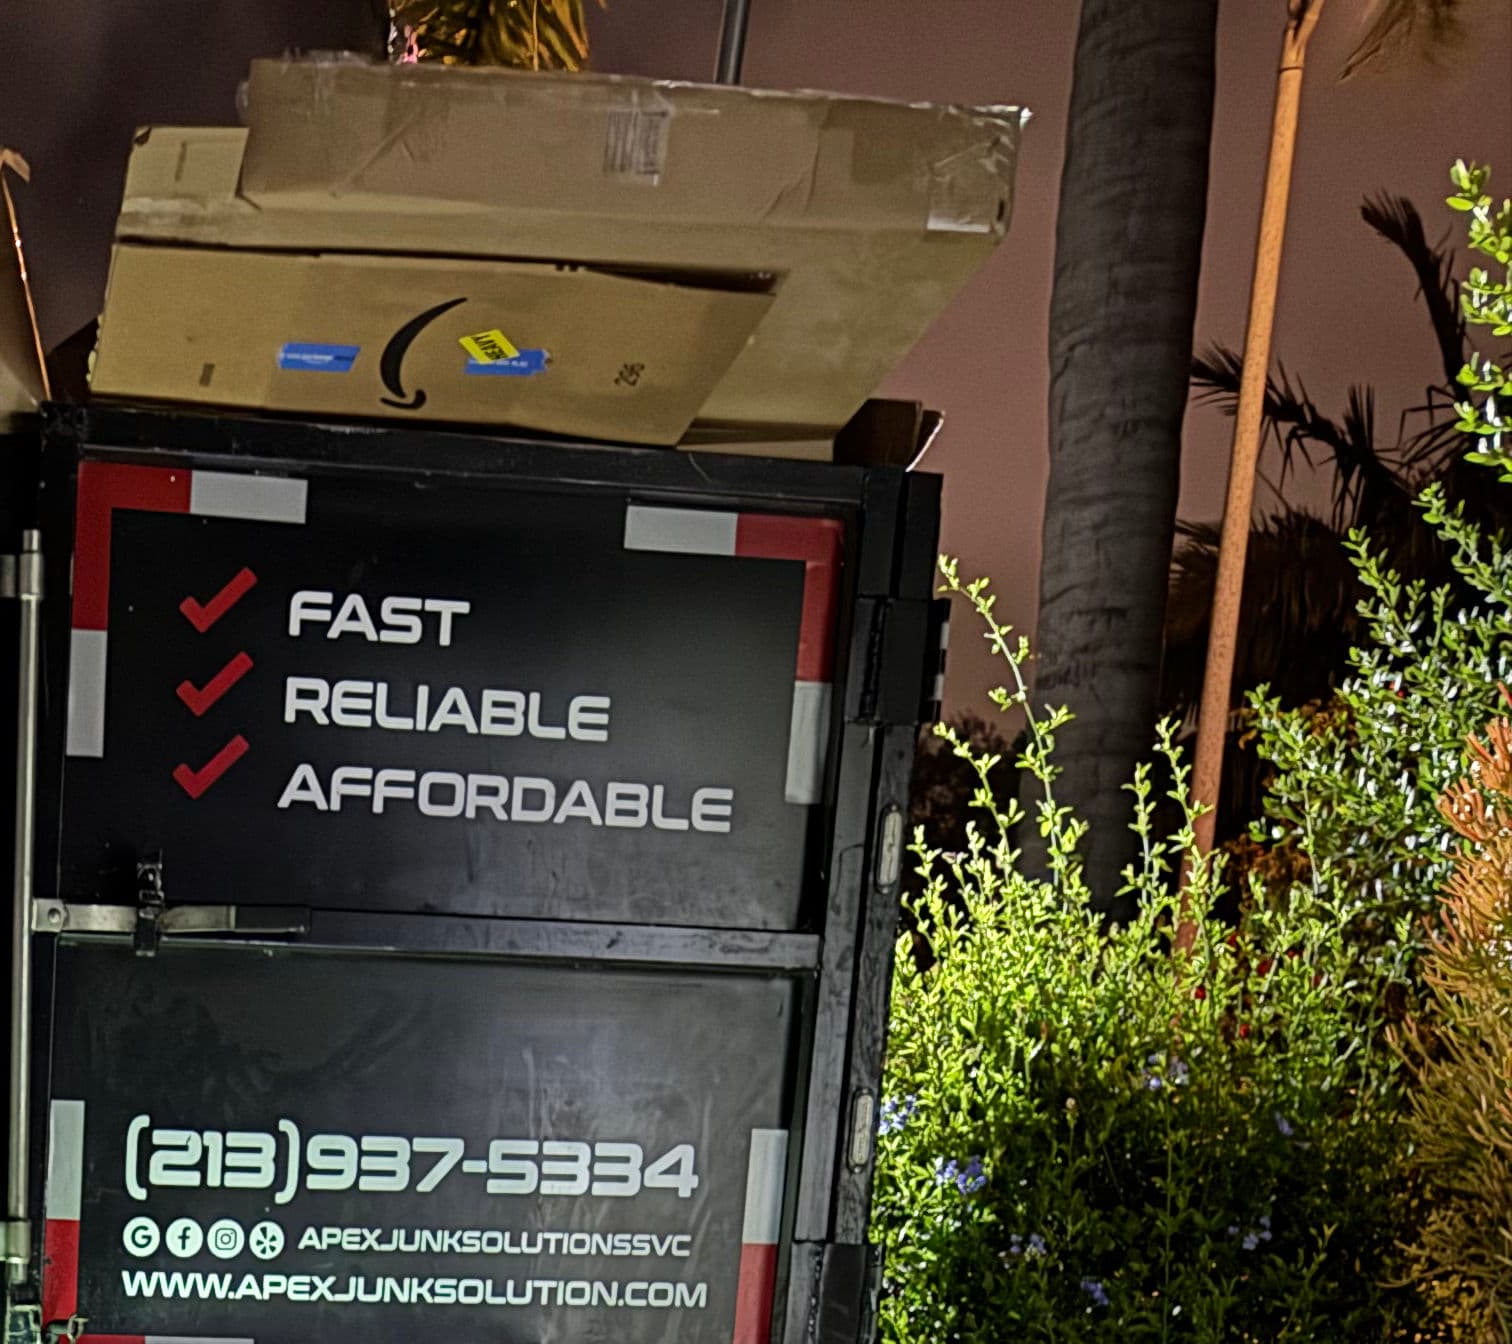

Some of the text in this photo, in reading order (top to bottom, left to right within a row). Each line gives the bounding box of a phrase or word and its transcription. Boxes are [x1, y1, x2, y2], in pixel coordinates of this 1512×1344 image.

[289, 591, 470, 646] FAST
[285, 677, 610, 741] RELIABLE
[278, 764, 733, 832] AFFORDABLE
[127, 1113, 699, 1204] (213)937-5334
[298, 1227, 691, 1256] APEXJUNKSOLUTIONSSVC
[122, 1271, 707, 1307] WWW.APEXJUNKSOLUTION.COM
